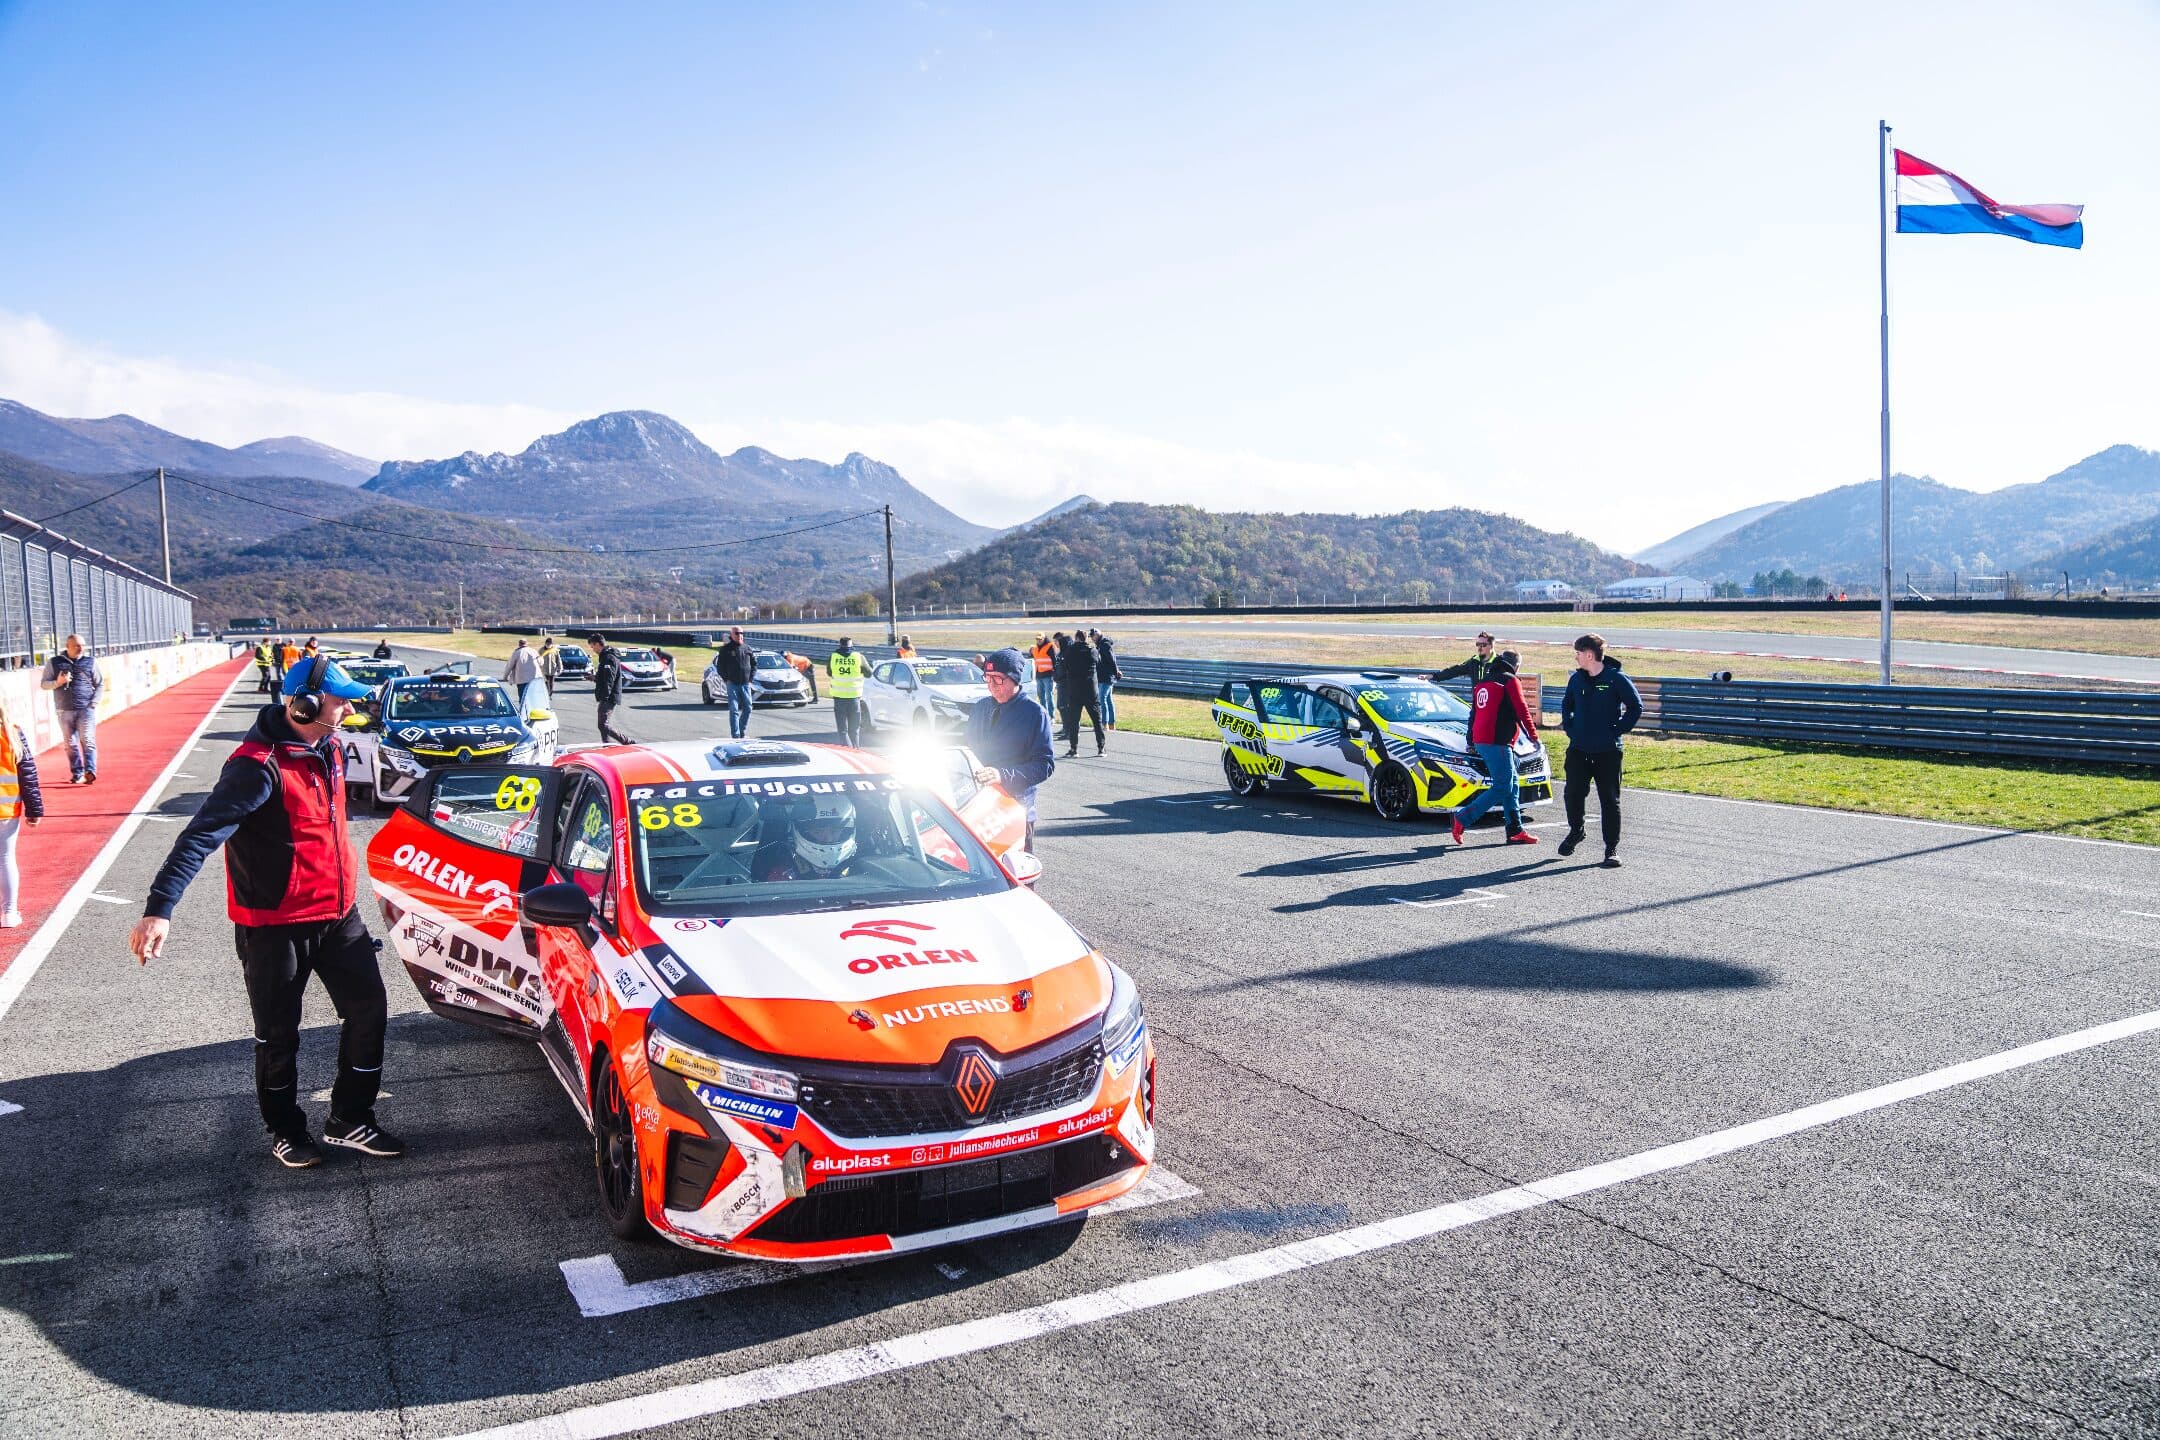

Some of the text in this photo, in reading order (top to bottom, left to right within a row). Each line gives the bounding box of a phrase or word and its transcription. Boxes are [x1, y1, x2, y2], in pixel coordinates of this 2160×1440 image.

[835, 658, 856, 666] PRESS
[838, 666, 851, 675] 94
[1361, 690, 1389, 702] 88
[428, 724, 522, 736] PREŠA
[495, 774, 542, 813] 68
[639, 803, 703, 830] 68
[393, 844, 475, 899] ORLEN
[661, 957, 681, 980] Lenovo
[848, 949, 978, 975] ORLEN
[445, 959, 543, 1017] WIND TURBINE SERVI
[615, 971, 639, 1003] SELIK
[882, 997, 1010, 1028] NUTREND
[712, 1095, 784, 1119] MICHELIN
[812, 1153, 891, 1172] aluplast
[733, 1183, 761, 1210] BOSCH
